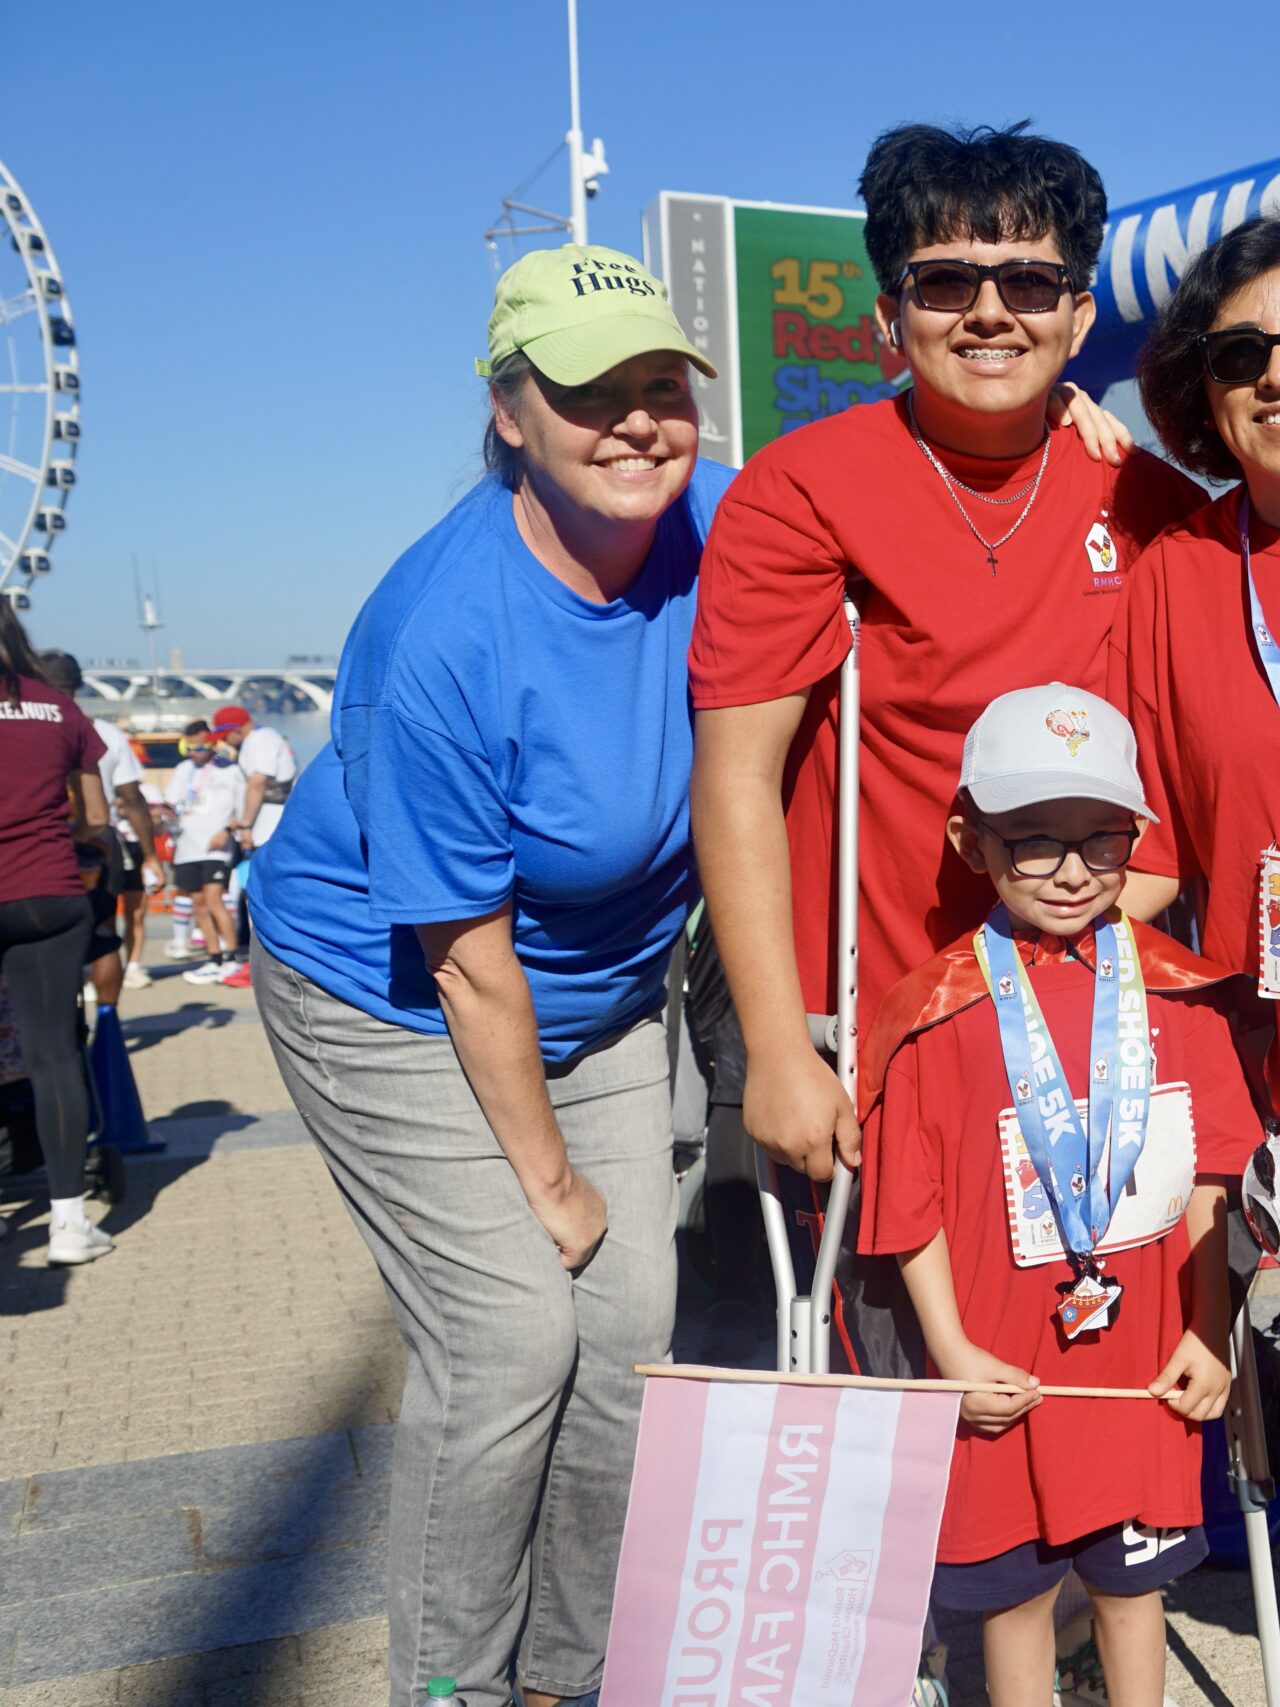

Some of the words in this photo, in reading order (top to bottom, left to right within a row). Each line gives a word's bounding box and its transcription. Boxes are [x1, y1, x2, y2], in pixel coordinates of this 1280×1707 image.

[569, 271, 656, 298] Hugs
[571, 257, 637, 276] Free
[691, 239, 711, 388] NATIONL
[773, 310, 877, 363] Red
[1093, 576, 1122, 588] RMHC
[1119, 989, 1147, 1090] SHOE
[1038, 1087, 1077, 1147] 5K
[1119, 1099, 1145, 1150] 5K
